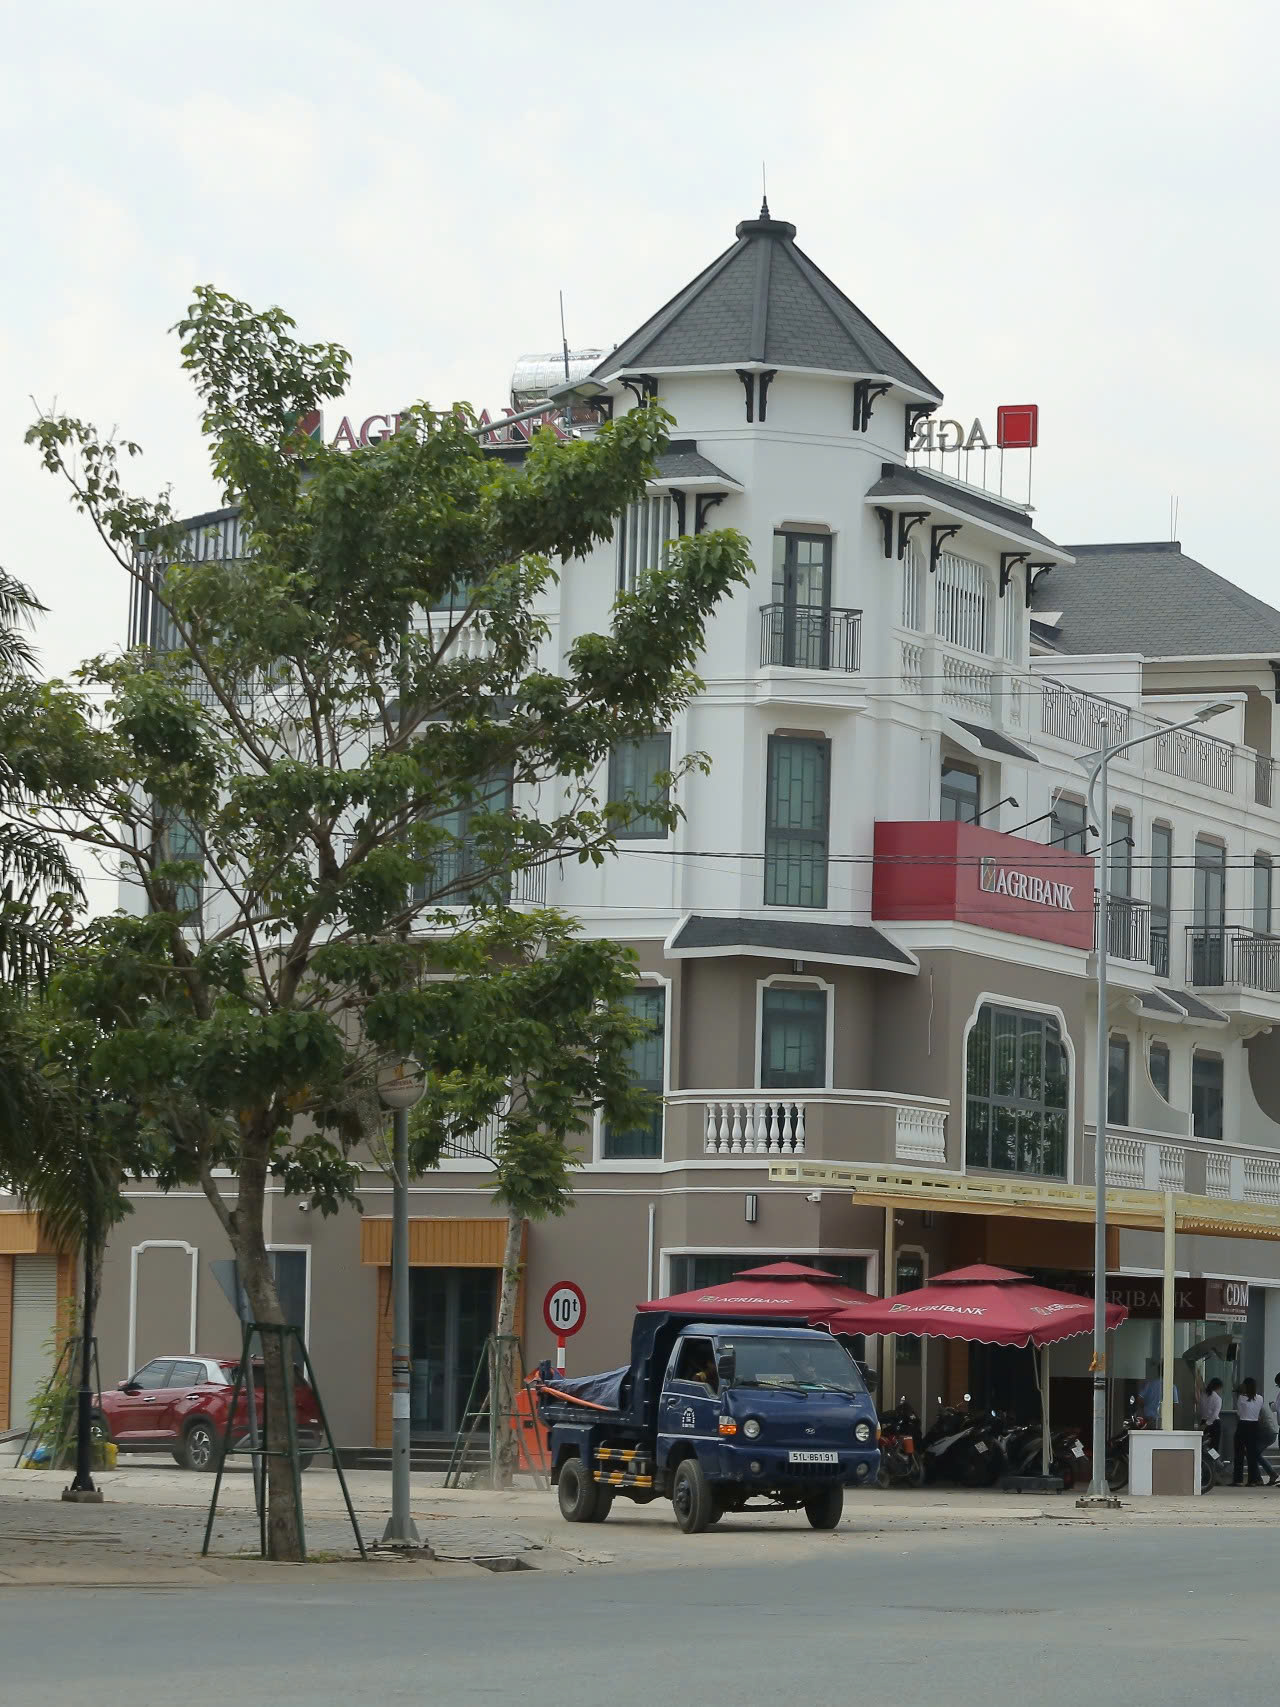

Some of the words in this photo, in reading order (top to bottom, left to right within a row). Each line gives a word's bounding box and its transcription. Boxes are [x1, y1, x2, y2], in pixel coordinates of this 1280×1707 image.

[333, 407, 577, 451] AGANK
[997, 869, 1075, 912] AGRIBANK
[1081, 1289, 1195, 1308] ARIBAK
[1226, 1283, 1248, 1307] CDM
[907, 1304, 987, 1316] AGRIBANK
